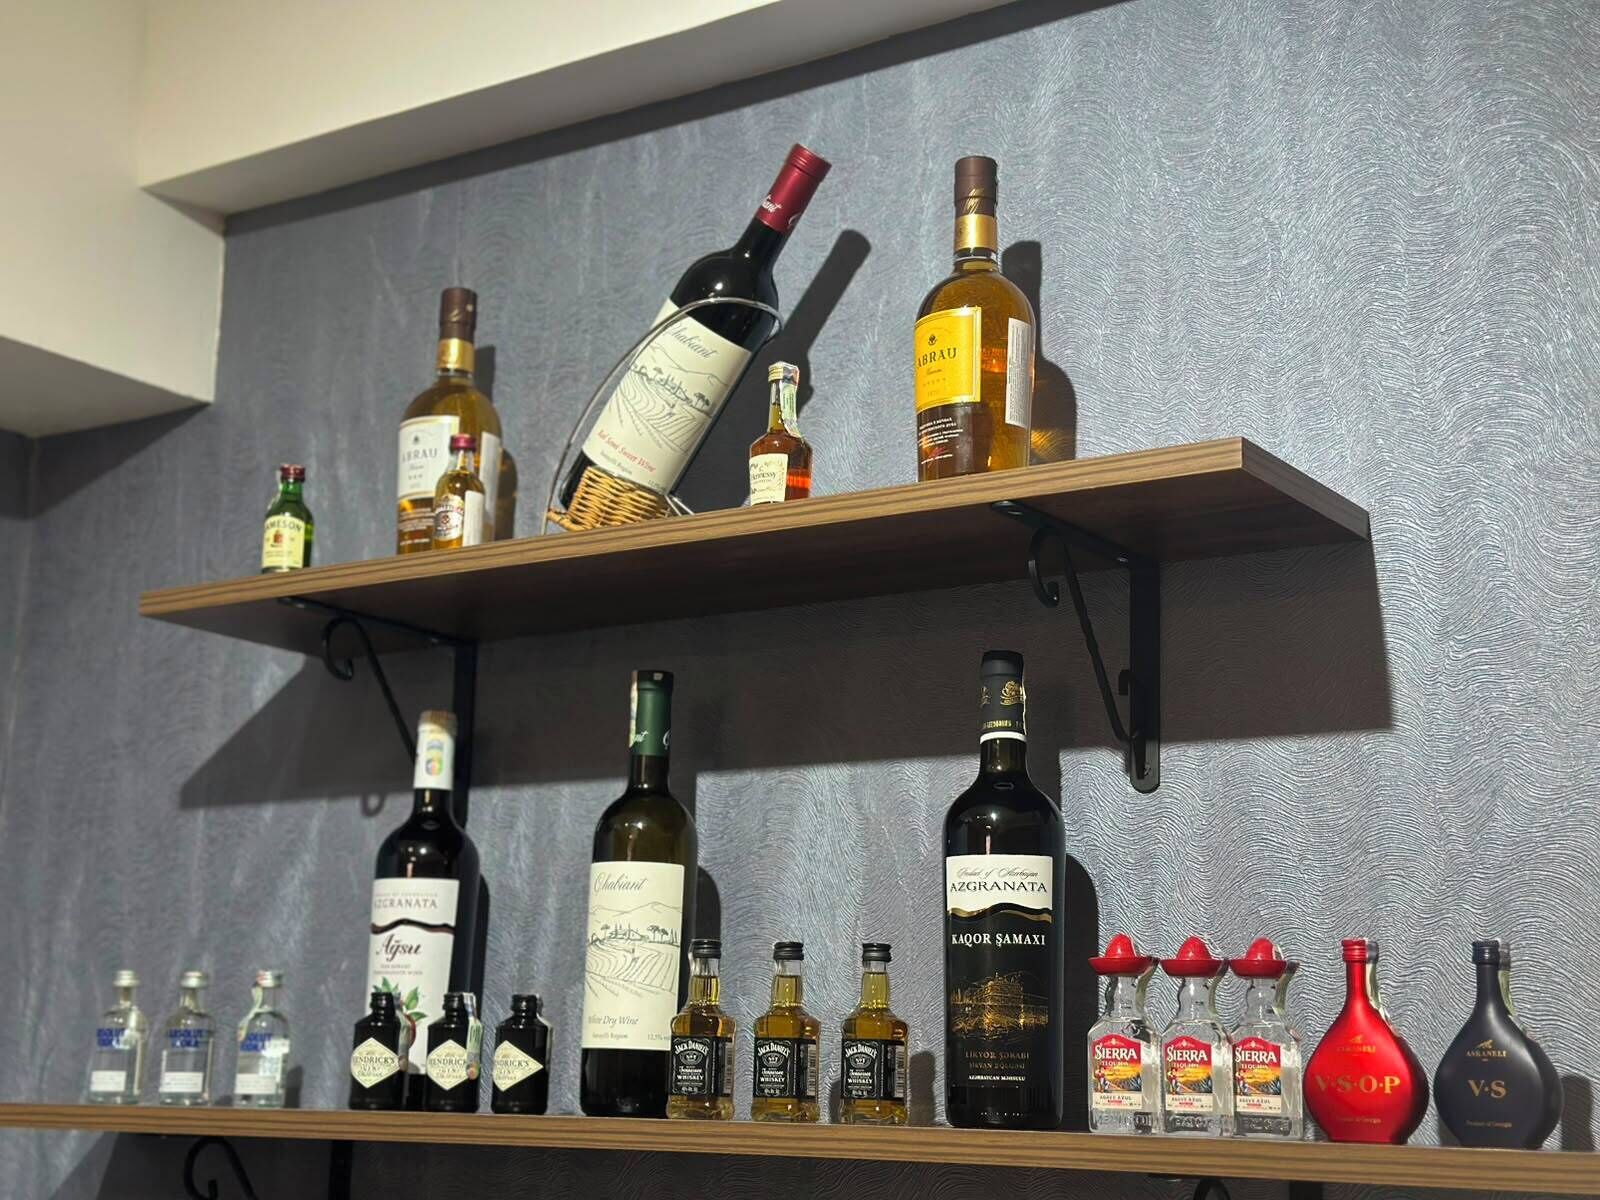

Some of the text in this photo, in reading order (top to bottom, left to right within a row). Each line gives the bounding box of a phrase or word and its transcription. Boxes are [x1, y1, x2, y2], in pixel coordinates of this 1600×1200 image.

[266, 519, 303, 532] AMESON
[593, 872, 648, 894] Chabiant
[950, 881, 1048, 893] AZGRANATA
[951, 933, 1046, 948] KAQOR ŞAMAXI
[602, 1015, 617, 1028] Dry
[619, 1015, 640, 1026] Wine
[674, 1043, 688, 1055] JACK
[757, 1044, 770, 1057] JACK
[845, 1045, 857, 1058] JACK
[1095, 1042, 1138, 1060] SIERRA
[1167, 1045, 1208, 1062] SIERRA
[1235, 1046, 1277, 1063] SIERRA
